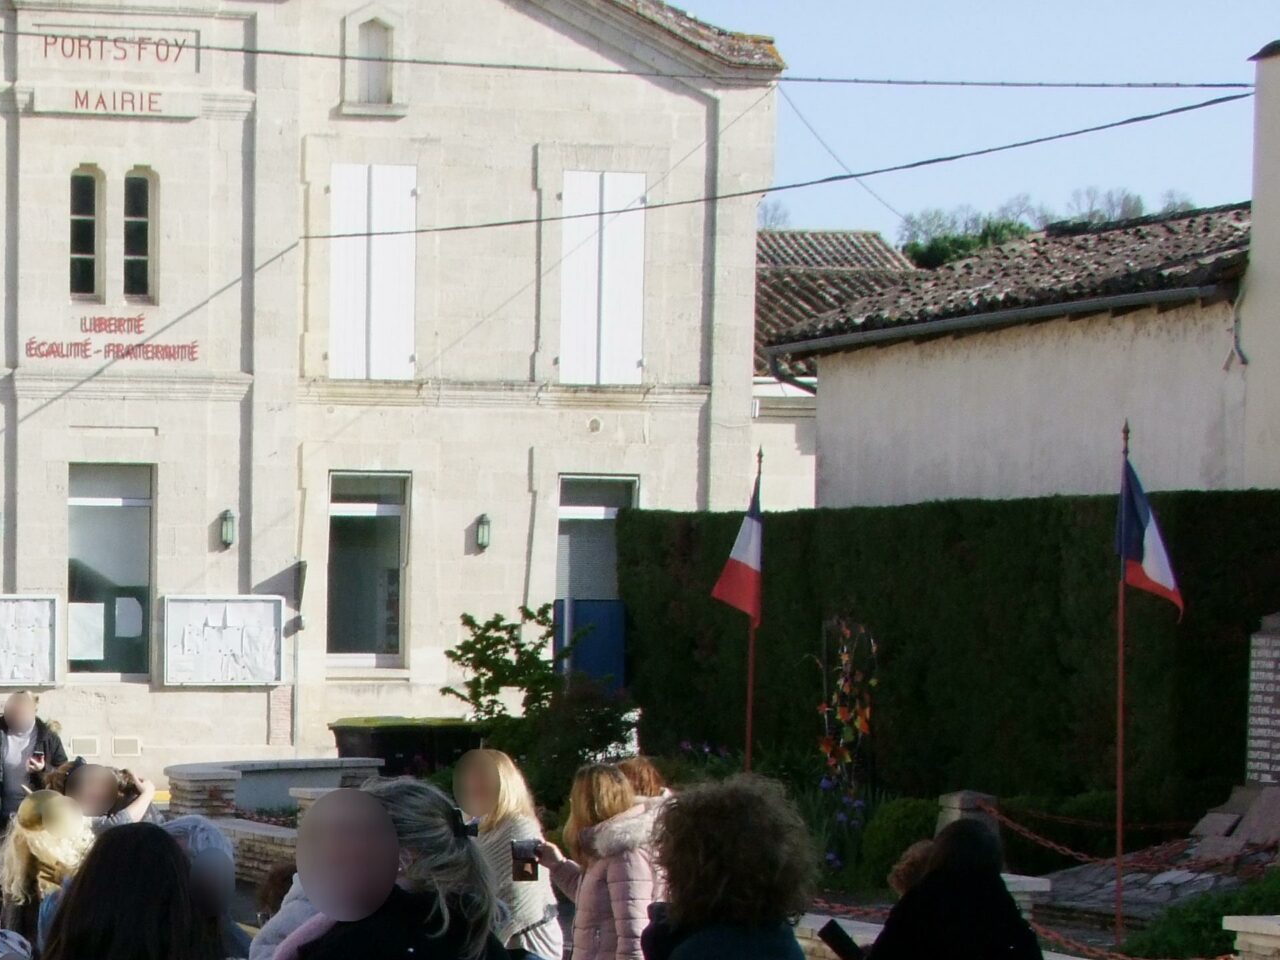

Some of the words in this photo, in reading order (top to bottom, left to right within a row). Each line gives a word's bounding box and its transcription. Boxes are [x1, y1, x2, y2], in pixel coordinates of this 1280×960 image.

[137, 37, 187, 63] FOY
[74, 89, 163, 113] MAIRIE
[80, 313, 145, 334] LIBERTÉ
[104, 340, 200, 361] FRATERNITÉ
